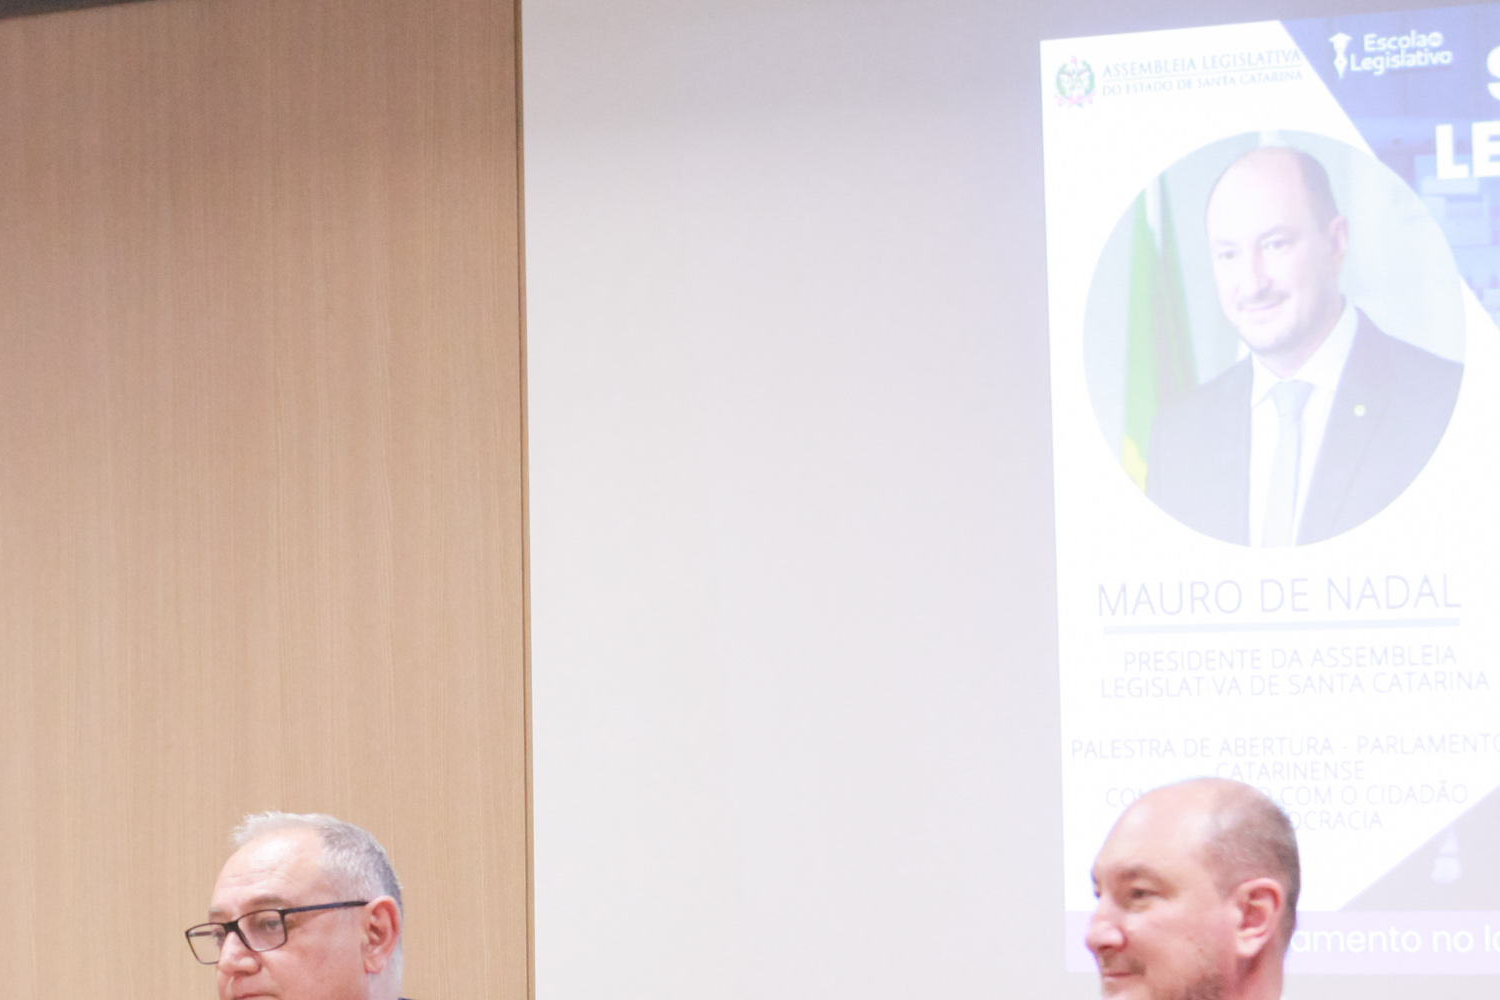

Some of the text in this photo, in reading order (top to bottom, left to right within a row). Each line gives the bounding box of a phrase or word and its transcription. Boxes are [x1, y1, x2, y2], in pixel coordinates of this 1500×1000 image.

[1102, 50, 1301, 78] ASSEMBLEIA LEGISLATIVA
[1351, 49, 1453, 75] Legislativo
[1102, 71, 1303, 96] DO ESTADO DE SANTA CATARINA
[1097, 574, 1461, 617] MAURO DE NADAL
[1124, 645, 1457, 671] PRESIDENTE DA ASSEMBLEIA
[1100, 671, 1490, 699] LEGISLATIVA DE SANTA CATARINA
[1072, 738, 1176, 758] PALESTRA
[1184, 738, 1211, 757] DE
[1219, 737, 1334, 757] ABERTURA
[1215, 761, 1365, 780] CATARINENSE
[1281, 786, 1331, 806] COM
[1341, 786, 1357, 805] O
[1366, 780, 1468, 805] CIDADÃO
[1432, 927, 1473, 952] no
